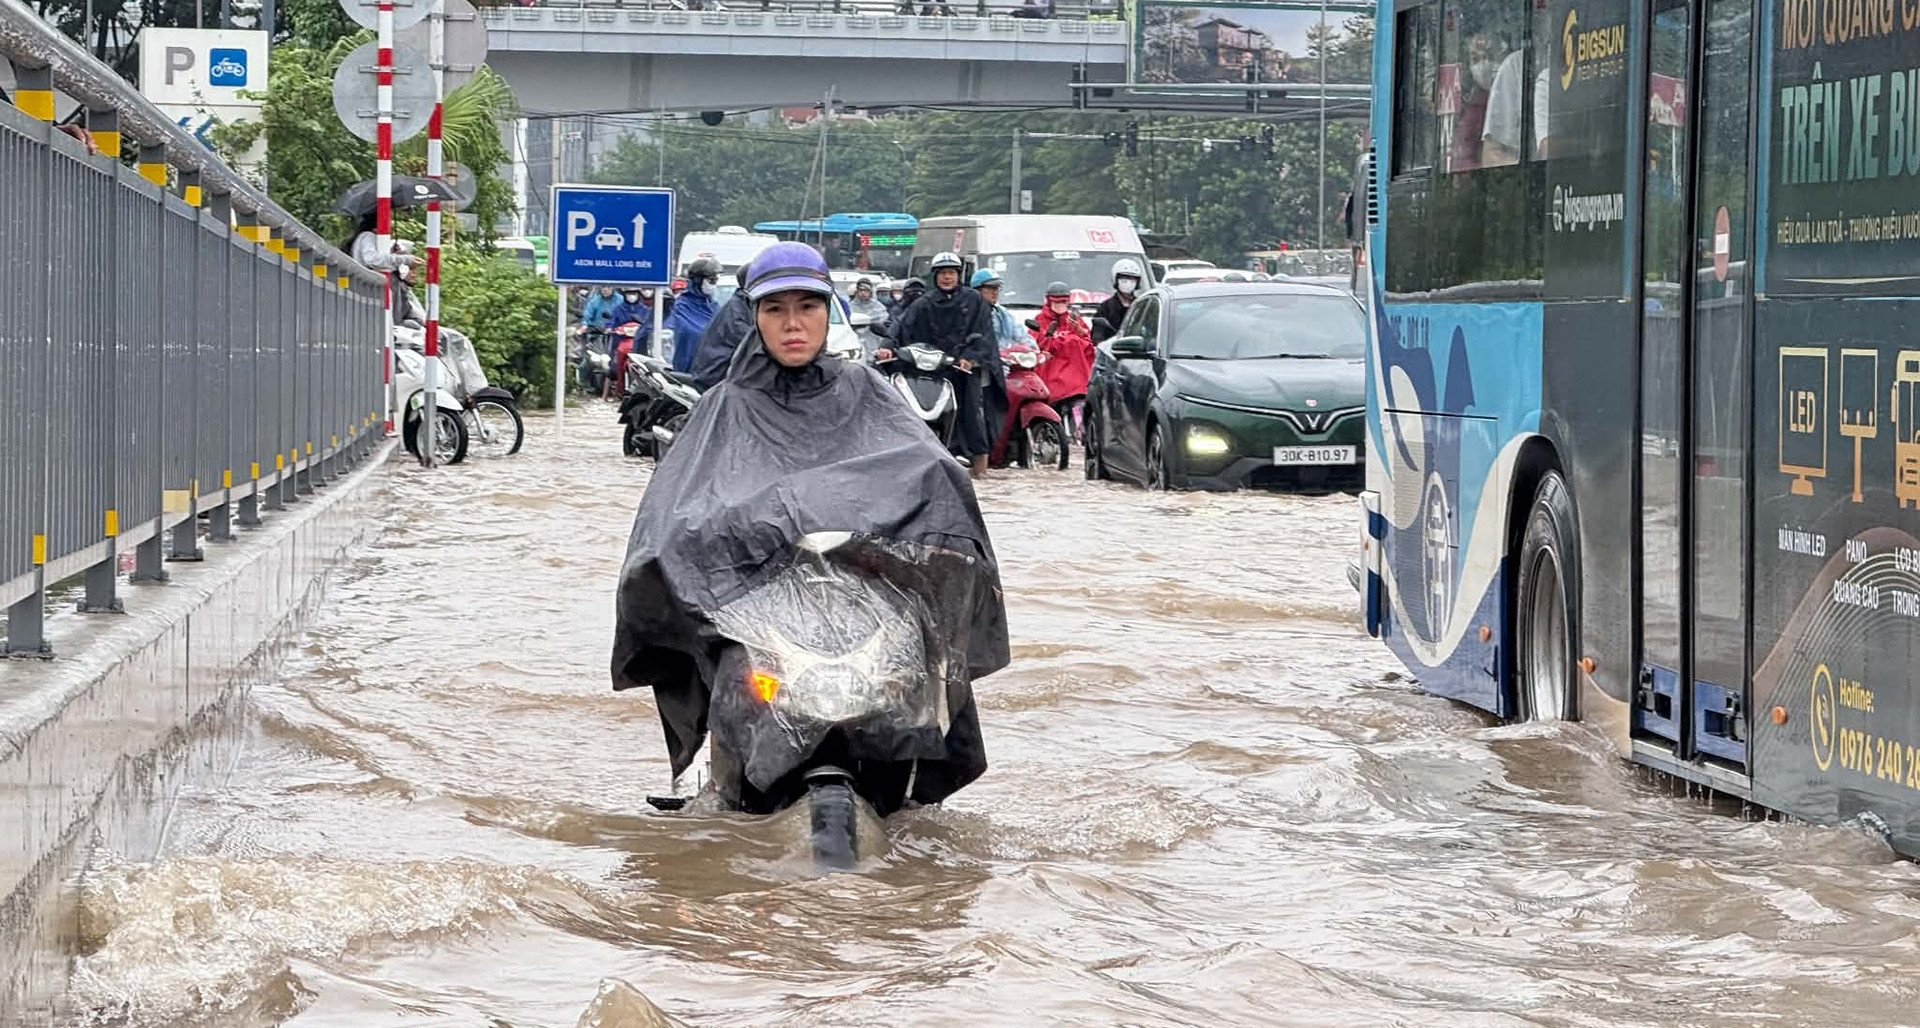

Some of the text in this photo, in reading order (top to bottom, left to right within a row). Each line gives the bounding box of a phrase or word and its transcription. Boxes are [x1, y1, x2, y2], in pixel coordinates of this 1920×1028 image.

[1577, 24, 1625, 61] BIGSUN
[165, 46, 195, 85] P
[1780, 60, 1842, 185] TRÊN
[1846, 74, 1882, 180] XE
[567, 211, 596, 251] P
[1789, 390, 1816, 433] LED
[1778, 523, 1794, 551] MÀN
[1811, 534, 1826, 557] LED
[1846, 540, 1867, 563] PANO
[1895, 547, 1912, 571] LCD
[1862, 580, 1879, 610] CÁO
[1892, 590, 1920, 617] TRONG
[1839, 677, 1875, 714] Hotline:
[1840, 727, 1874, 776] 0976
[1876, 737, 1902, 784] 240
